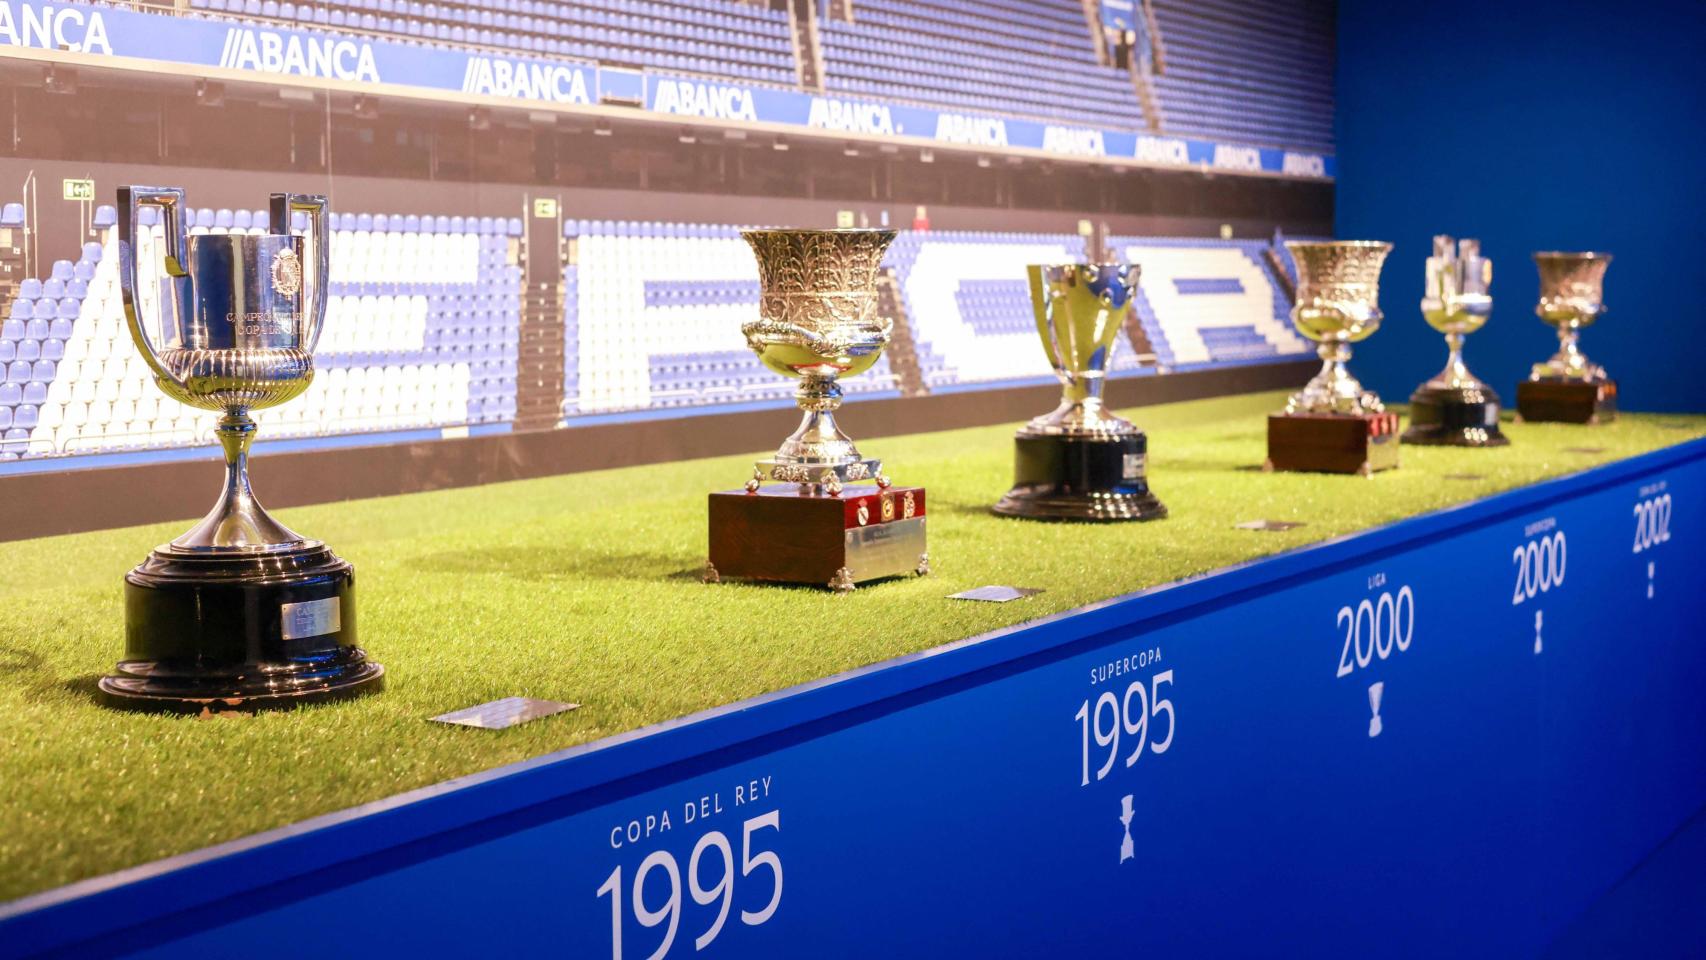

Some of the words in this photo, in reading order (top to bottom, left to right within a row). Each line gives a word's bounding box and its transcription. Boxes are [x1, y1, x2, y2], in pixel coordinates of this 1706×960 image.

[1632, 493, 1672, 553] 2002
[1512, 530, 1567, 605] 2000
[1090, 646, 1162, 685] SUPERCOPA
[1336, 584, 1414, 678] 2000
[1074, 668, 1176, 787] 1995
[610, 810, 672, 849] COPA
[684, 792, 723, 824] DEL
[735, 775, 772, 807] REY
[596, 809, 784, 960] 1995
